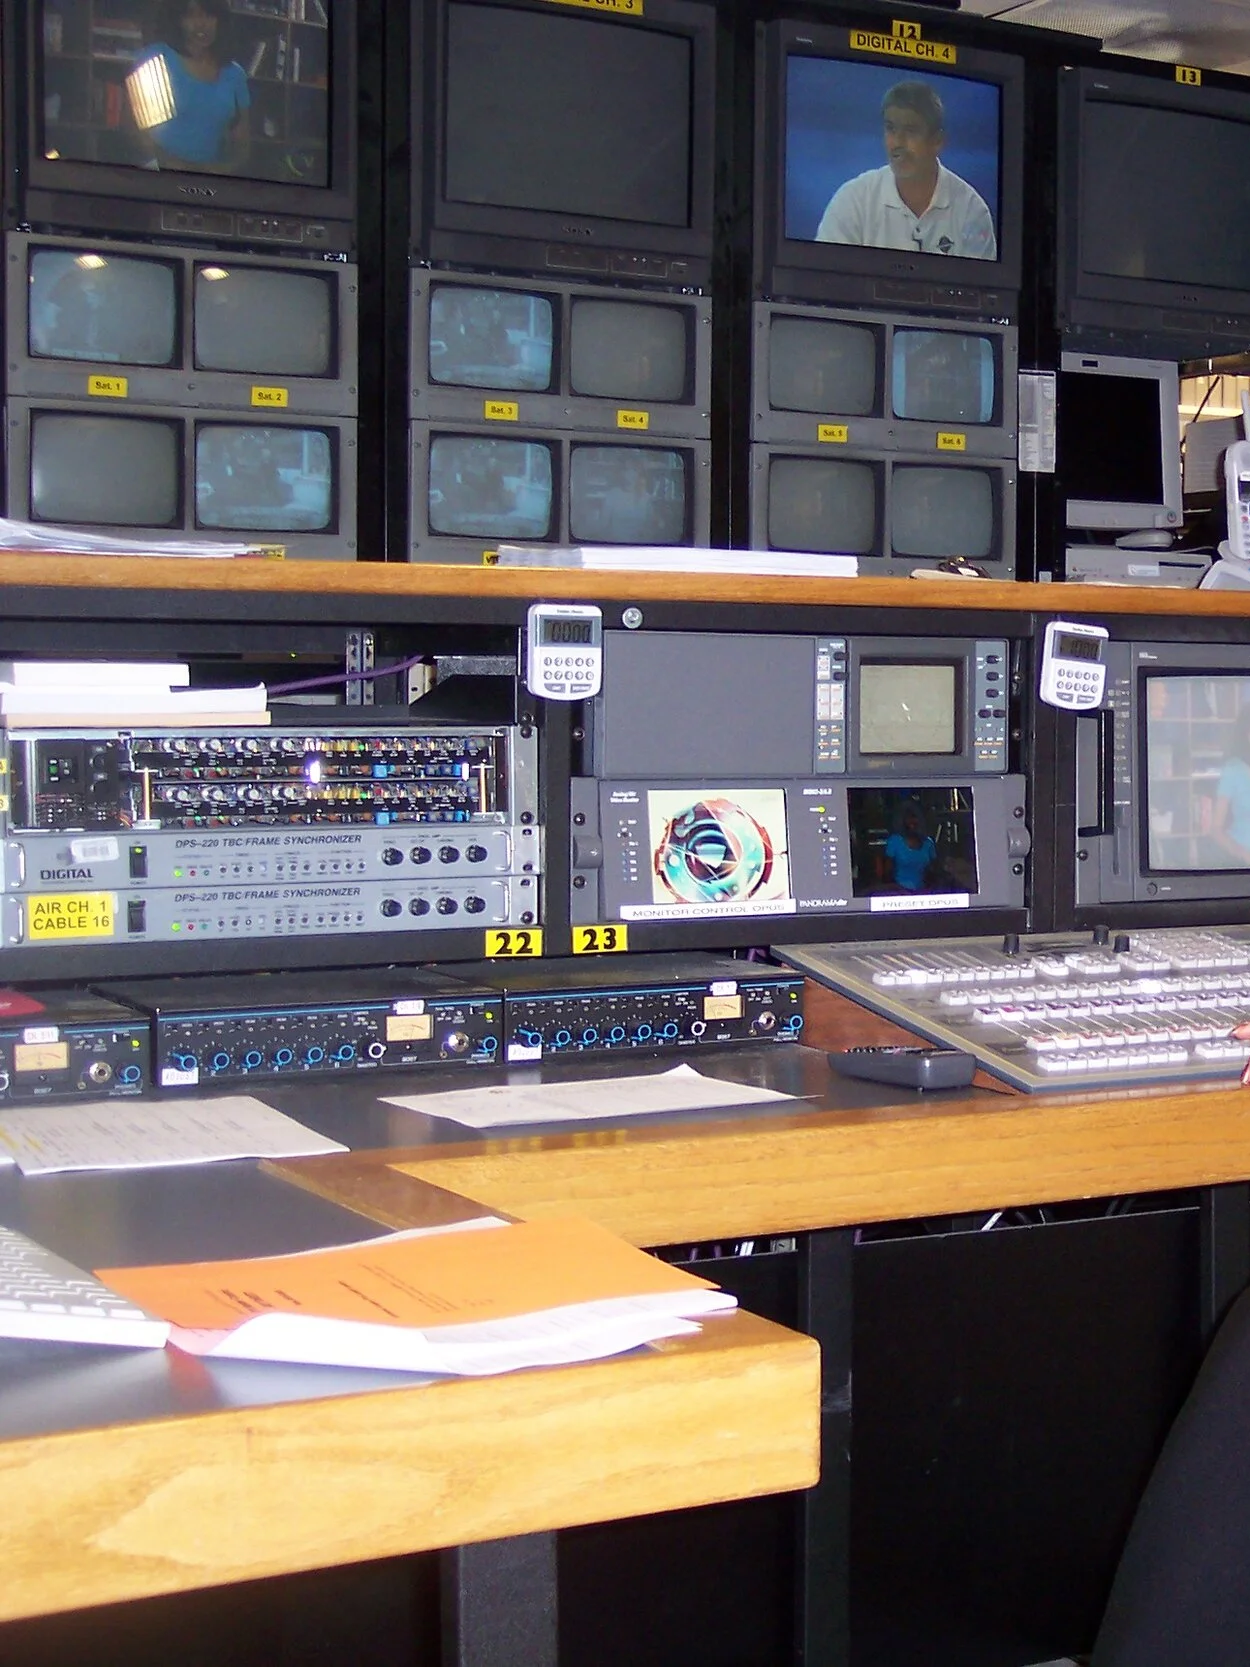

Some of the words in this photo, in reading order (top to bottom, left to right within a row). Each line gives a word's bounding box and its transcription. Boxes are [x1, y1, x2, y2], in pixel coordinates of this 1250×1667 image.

[900, 23, 917, 39] 12
[857, 34, 912, 54] DIGITAL
[916, 43, 939, 58] CH.
[942, 47, 951, 59] 4
[1182, 69, 1197, 83] 13
[95, 381, 113, 390] Sat.
[116, 382, 121, 391] 1
[276, 392, 282, 401] 2
[175, 837, 219, 849] DPS-220
[283, 834, 362, 846] SYNCHRONIZER
[40, 868, 94, 880] DIGITAL
[174, 890, 218, 903] DPS-220
[282, 886, 361, 899] SYNCHRONIZER
[34, 902, 61, 916] AIR
[67, 900, 93, 914] CH.
[100, 899, 107, 912] 1
[632, 907, 689, 918] MONITOR
[692, 905, 748, 915] CONTROL
[752, 903, 785, 913] OPUS
[882, 900, 925, 909] PRESET
[33, 916, 87, 931] CABLE
[93, 915, 110, 928] 16
[495, 932, 533, 955] 22
[582, 927, 617, 951] 23
